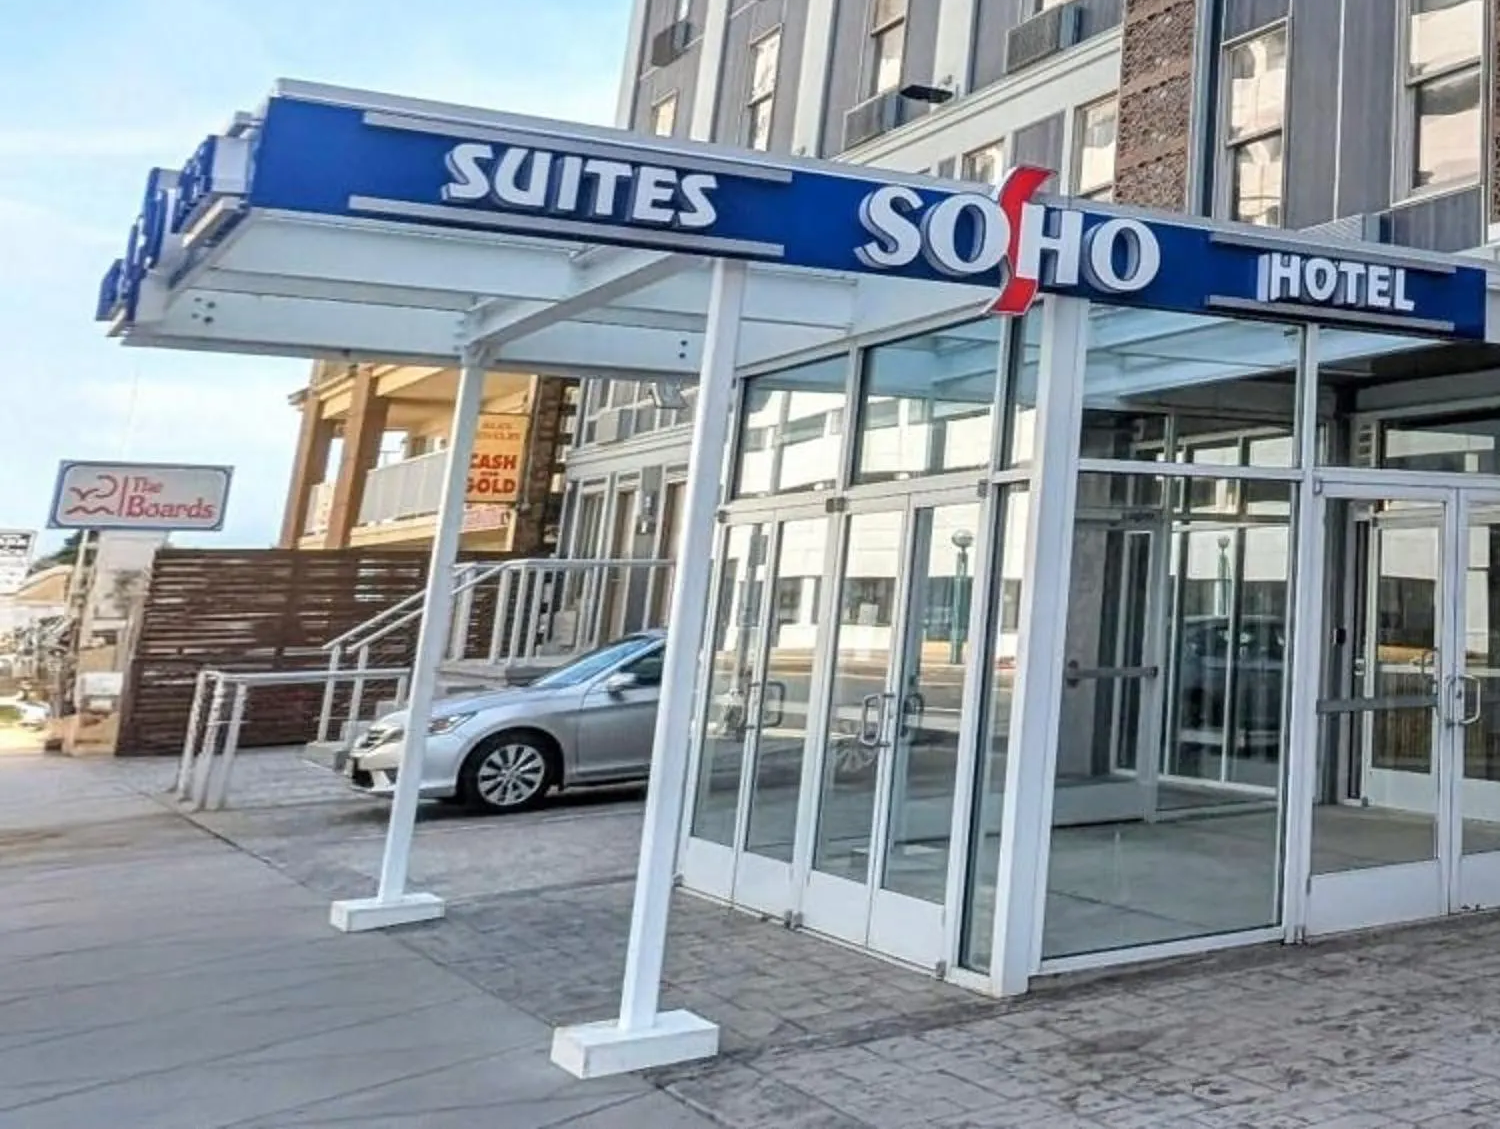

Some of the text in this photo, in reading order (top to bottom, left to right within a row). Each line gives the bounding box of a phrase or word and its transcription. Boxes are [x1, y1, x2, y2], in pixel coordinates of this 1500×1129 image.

[441, 142, 718, 228] SUITES
[854, 185, 1161, 293] SOHO
[1257, 252, 1415, 311] HOTEL
[126, 494, 216, 519] Boards
[133, 476, 163, 493] The
